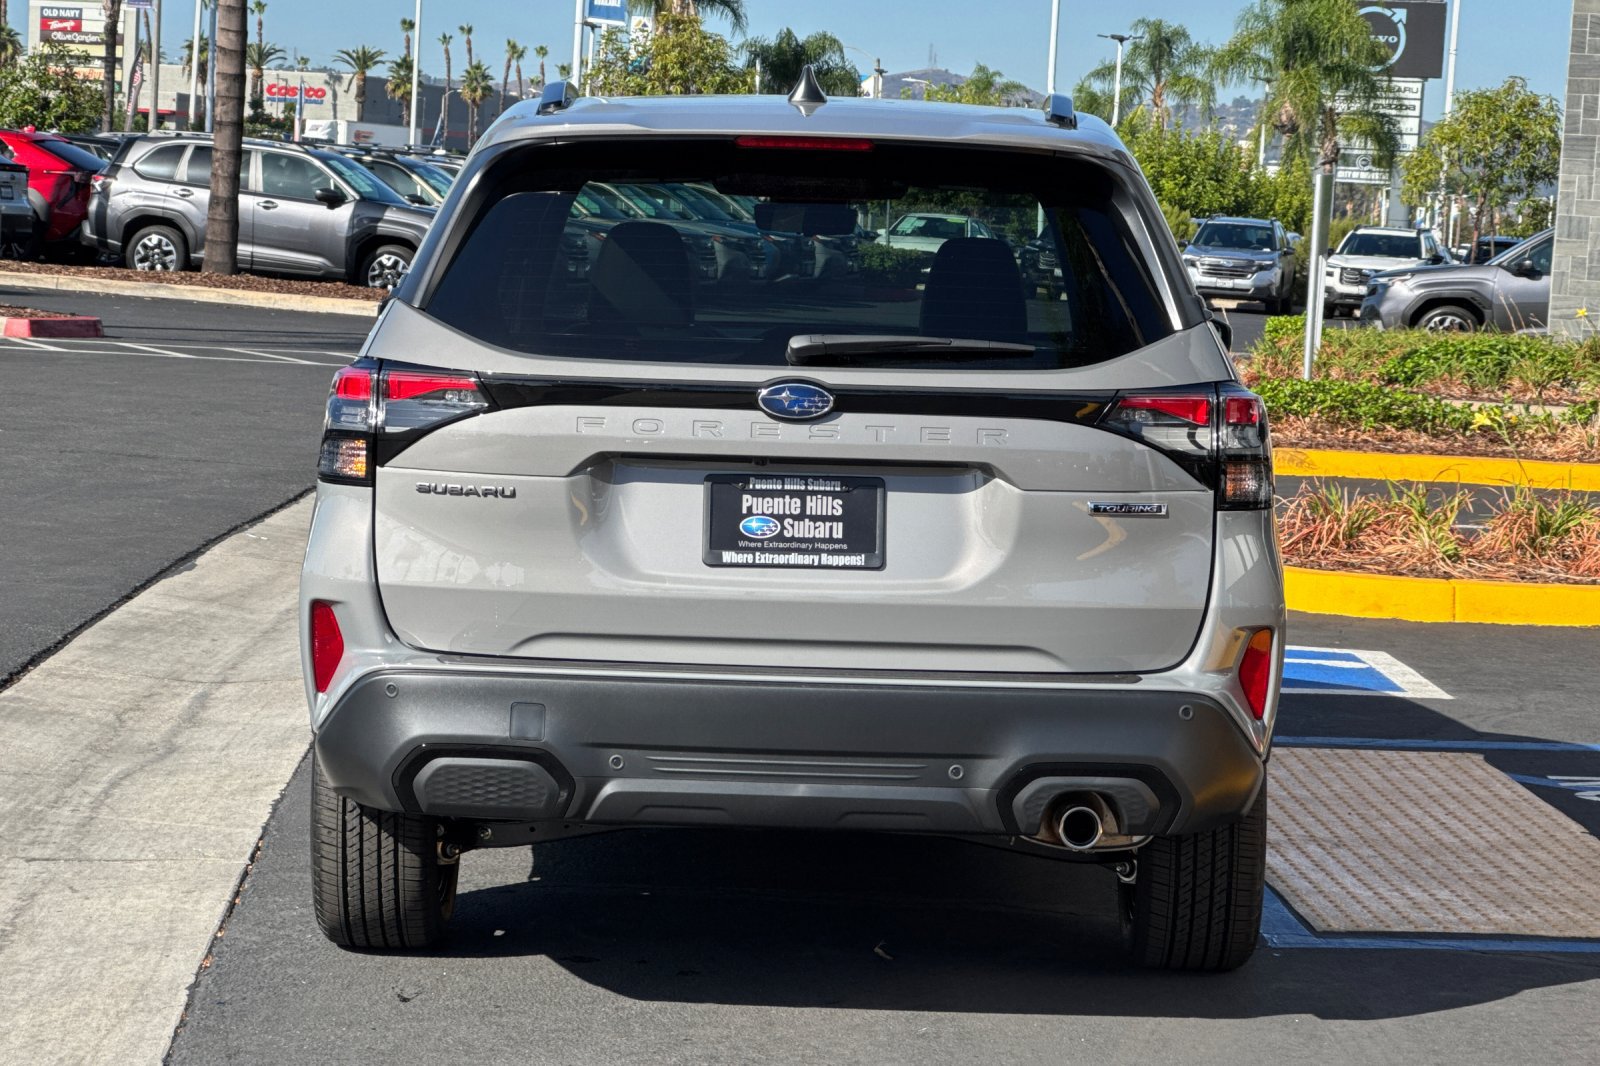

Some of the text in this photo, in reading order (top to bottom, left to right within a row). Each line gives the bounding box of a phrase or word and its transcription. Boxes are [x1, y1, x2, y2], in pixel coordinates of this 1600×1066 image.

[43, 8, 80, 17] OLD NAVY
[51, 31, 102, 43] Olive Garden
[266, 83, 326, 98] COSCO
[575, 415, 1009, 446] FORESTER
[416, 482, 516, 499] SUBARU
[749, 476, 841, 492] Puente Hills Subaru
[742, 494, 843, 516] Puente Hills
[1097, 505, 1158, 513] TOURING
[783, 518, 843, 539] Subaru
[738, 540, 848, 550] Where Extraordinary Happens
[722, 551, 865, 566] Where Extraordinary Happens!
